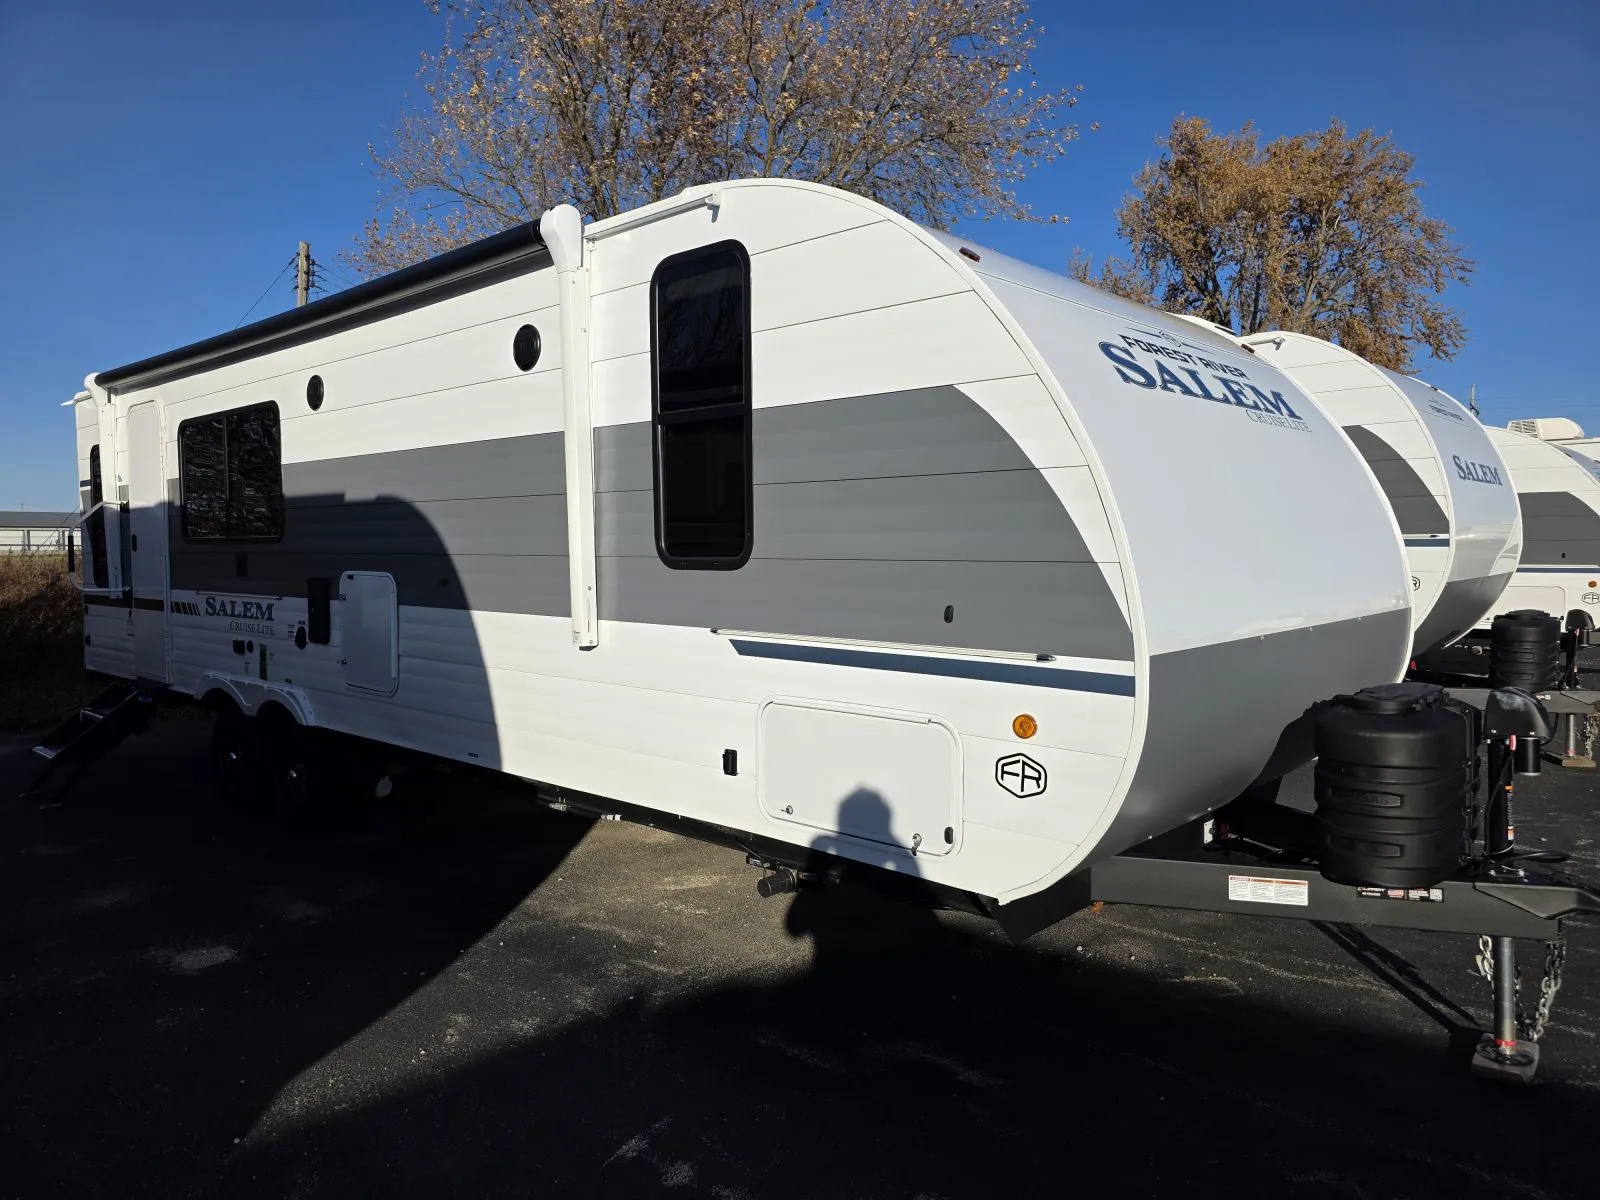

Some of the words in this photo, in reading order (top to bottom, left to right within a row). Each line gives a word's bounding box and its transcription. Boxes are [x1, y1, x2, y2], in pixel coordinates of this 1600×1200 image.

[1118, 333, 1197, 366] FOREST
[1196, 356, 1250, 381] RIVER
[1098, 341, 1304, 421] SALEM
[1452, 454, 1503, 486] SALEM
[205, 596, 275, 621] SALEM
[1000, 758, 1042, 793] FR
